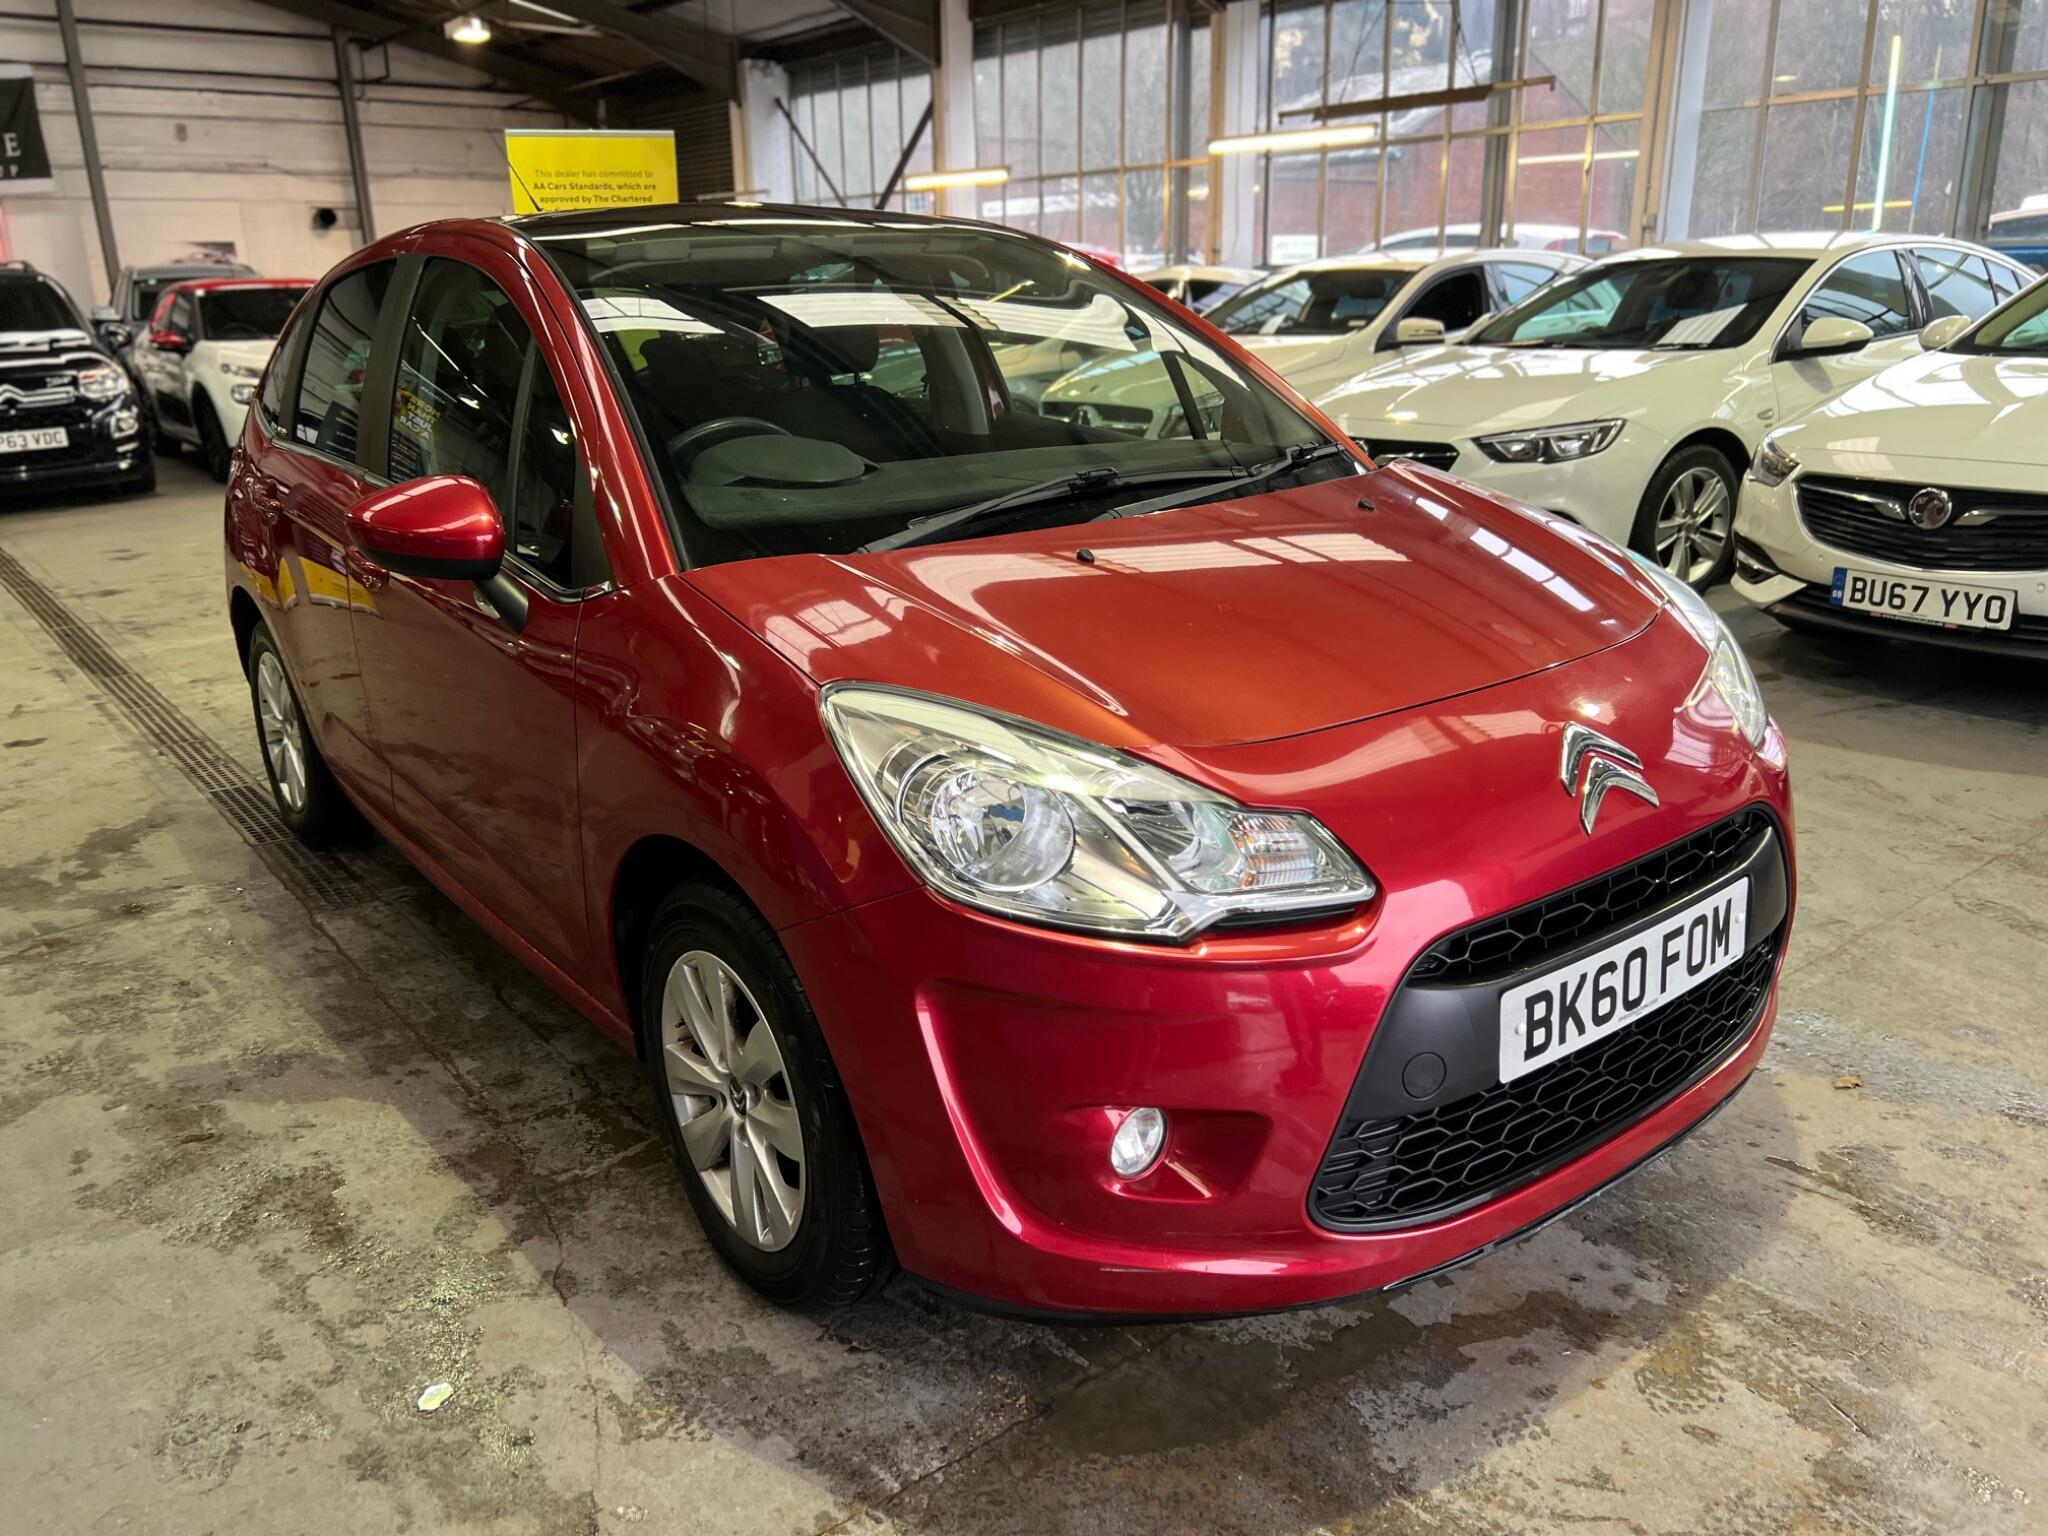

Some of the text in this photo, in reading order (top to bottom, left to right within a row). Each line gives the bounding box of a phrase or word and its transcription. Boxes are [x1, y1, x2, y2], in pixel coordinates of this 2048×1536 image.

[535, 169, 654, 178] This dealer has committed to
[533, 183, 657, 191] AA Cars Standards, which are
[540, 194, 653, 204] approved by The Chartered
[1849, 576, 1930, 613] BU67
[1940, 589, 2007, 624] YYO
[1523, 897, 1733, 1062] BK60 FOM
